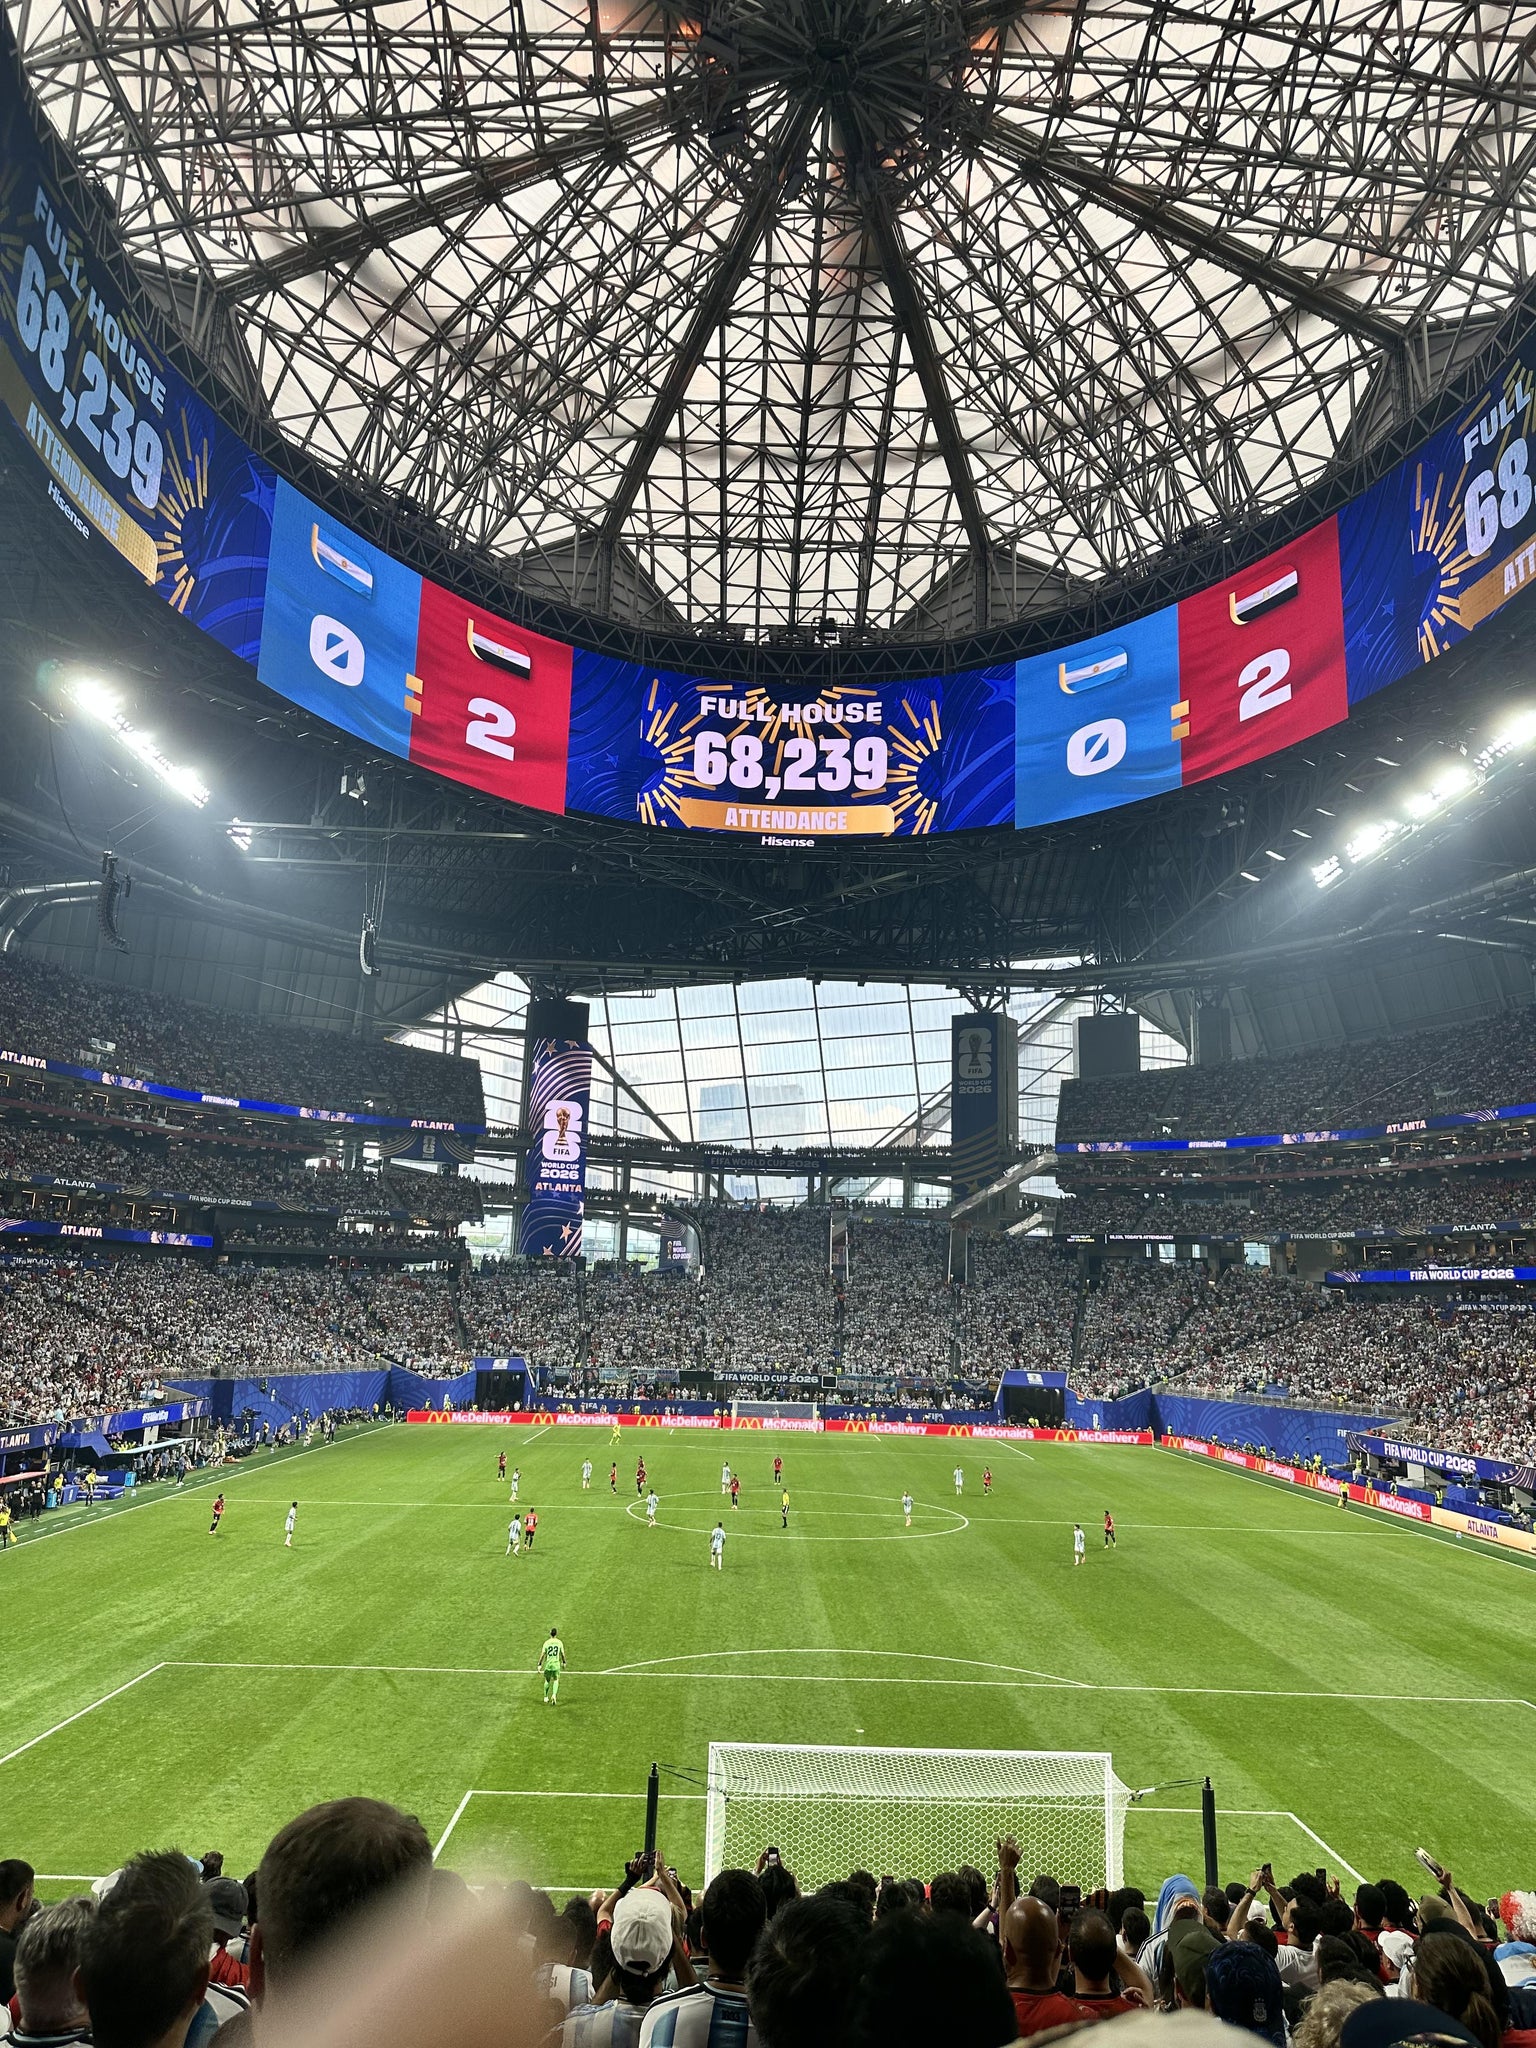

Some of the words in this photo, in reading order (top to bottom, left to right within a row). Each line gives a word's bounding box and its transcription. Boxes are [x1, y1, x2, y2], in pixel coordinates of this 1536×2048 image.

[34, 185, 83, 299] FULL
[88, 299, 166, 414] HOUSE
[17, 244, 165, 509] 68,239
[1463, 379, 1531, 464] FULL
[25, 402, 122, 541] ATTENDANCE
[1464, 438, 1536, 557] 68
[48, 480, 90, 539] Hisense
[1238, 648, 1292, 722] 2
[700, 696, 773, 722] FULL
[781, 701, 883, 724] HOUSE
[465, 697, 517, 762] 2
[693, 730, 888, 800] 68,239
[724, 807, 848, 831] ATTENDANCE
[760, 835, 815, 848] Hisense
[0, 1050, 47, 1070] ATLANTA
[958, 1085, 992, 1094] 2026
[411, 1120, 455, 1131] ATLANTA
[1386, 1119, 1426, 1134] ATLANTA
[553, 1148, 570, 1156] FIFA
[541, 1161, 566, 1169] WORLD
[710, 1157, 731, 1167] FIFA
[732, 1158, 766, 1167] WORLD
[767, 1159, 786, 1168] CUP
[786, 1160, 820, 1169] 2026
[540, 1169, 579, 1180] 2026
[53, 1177, 96, 1189] ATLANTA
[535, 1182, 582, 1193] ATLANTA
[200, 1196, 217, 1204] WORLD
[217, 1197, 230, 1205] CUP
[345, 1208, 390, 1216] ATLANTA
[60, 1224, 103, 1238] ATLANTA
[1452, 1223, 1497, 1232] ATLANTA
[1410, 1271, 1429, 1281] FIFA
[1429, 1270, 1460, 1280] WORLD
[1461, 1270, 1480, 1280] CUP
[1480, 1269, 1515, 1279] 2026
[721, 1373, 738, 1381] FIFA
[739, 1374, 770, 1382] WORLD
[789, 1376, 819, 1384] 2026
[451, 1412, 512, 1424] McDelivery
[556, 1413, 618, 1425] McDonald's
[661, 1415, 720, 1428] McDelivery
[762, 1419, 824, 1431] McDonald's
[868, 1421, 927, 1435] McDelivery
[972, 1426, 1034, 1439] McDonald's
[1078, 1430, 1140, 1444] McDelivery
[1384, 1443, 1400, 1458] FIFA
[1400, 1446, 1427, 1462] WORLD
[1428, 1453, 1445, 1467] CUP
[1445, 1455, 1477, 1473] 2026
[1379, 1492, 1423, 1519] McDonald's
[1467, 1519, 1498, 1538] ATLANTA
[547, 1645, 559, 1657] 23
